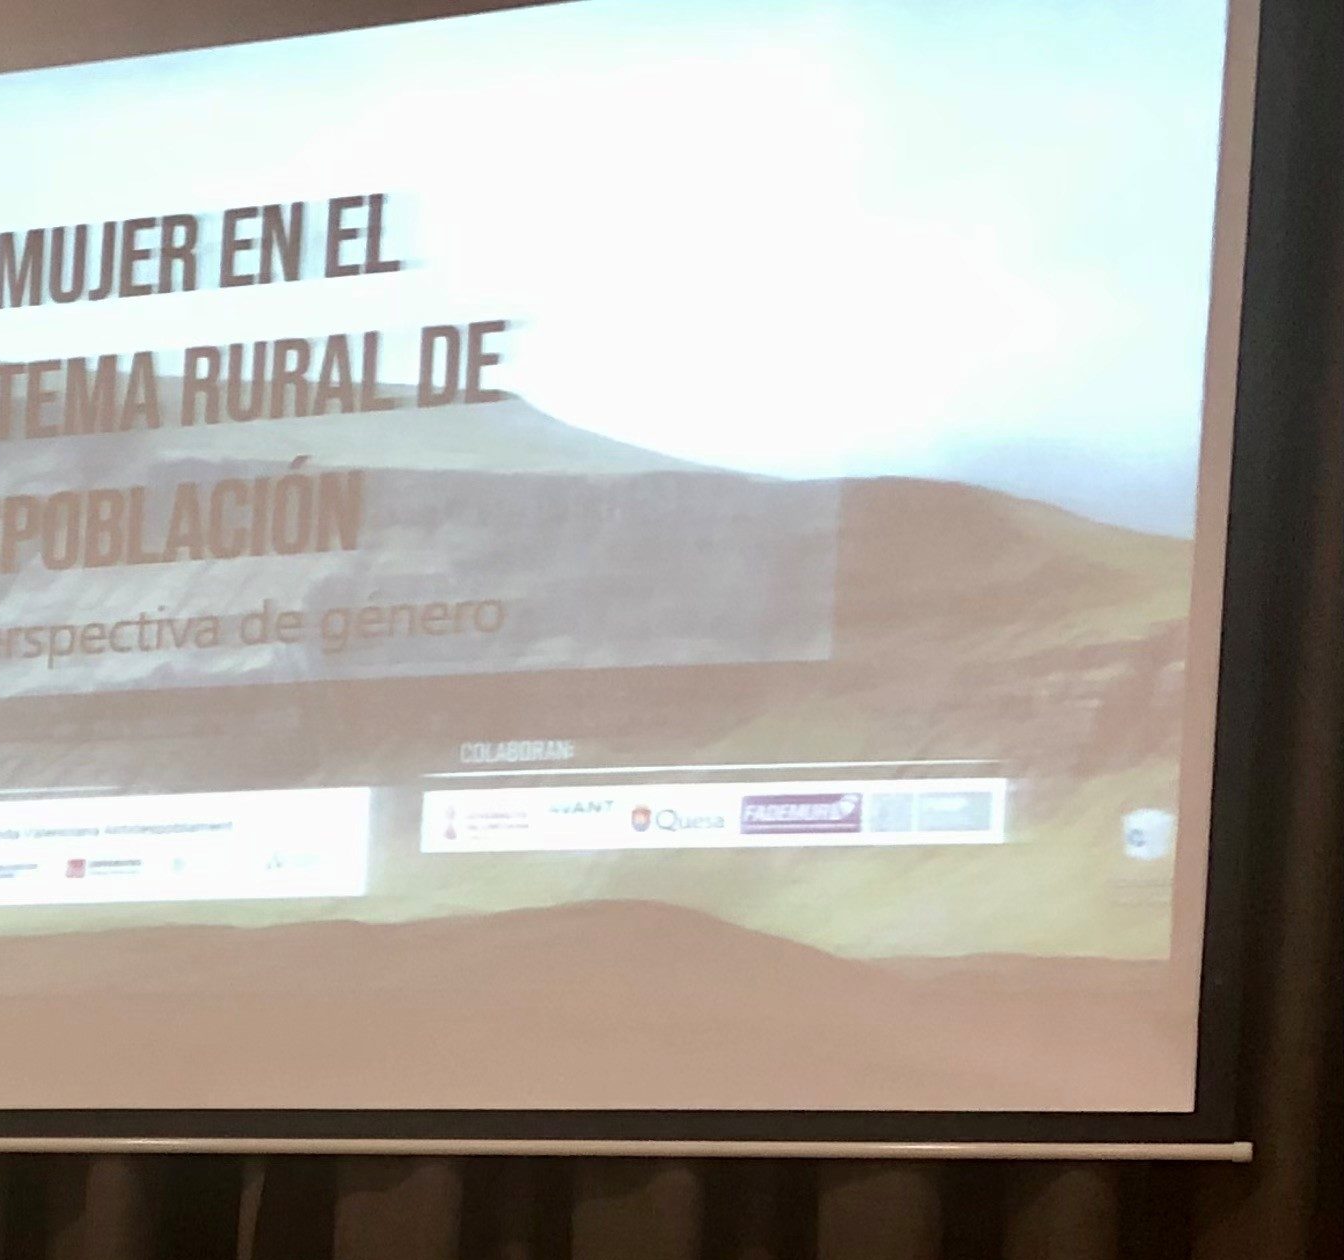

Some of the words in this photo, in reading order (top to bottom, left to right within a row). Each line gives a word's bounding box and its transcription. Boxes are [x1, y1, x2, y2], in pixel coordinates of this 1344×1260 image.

[219, 202, 304, 289] EN
[324, 193, 402, 278] EL
[181, 330, 396, 426] RURAL
[417, 319, 511, 408] DE
[240, 598, 304, 646] de
